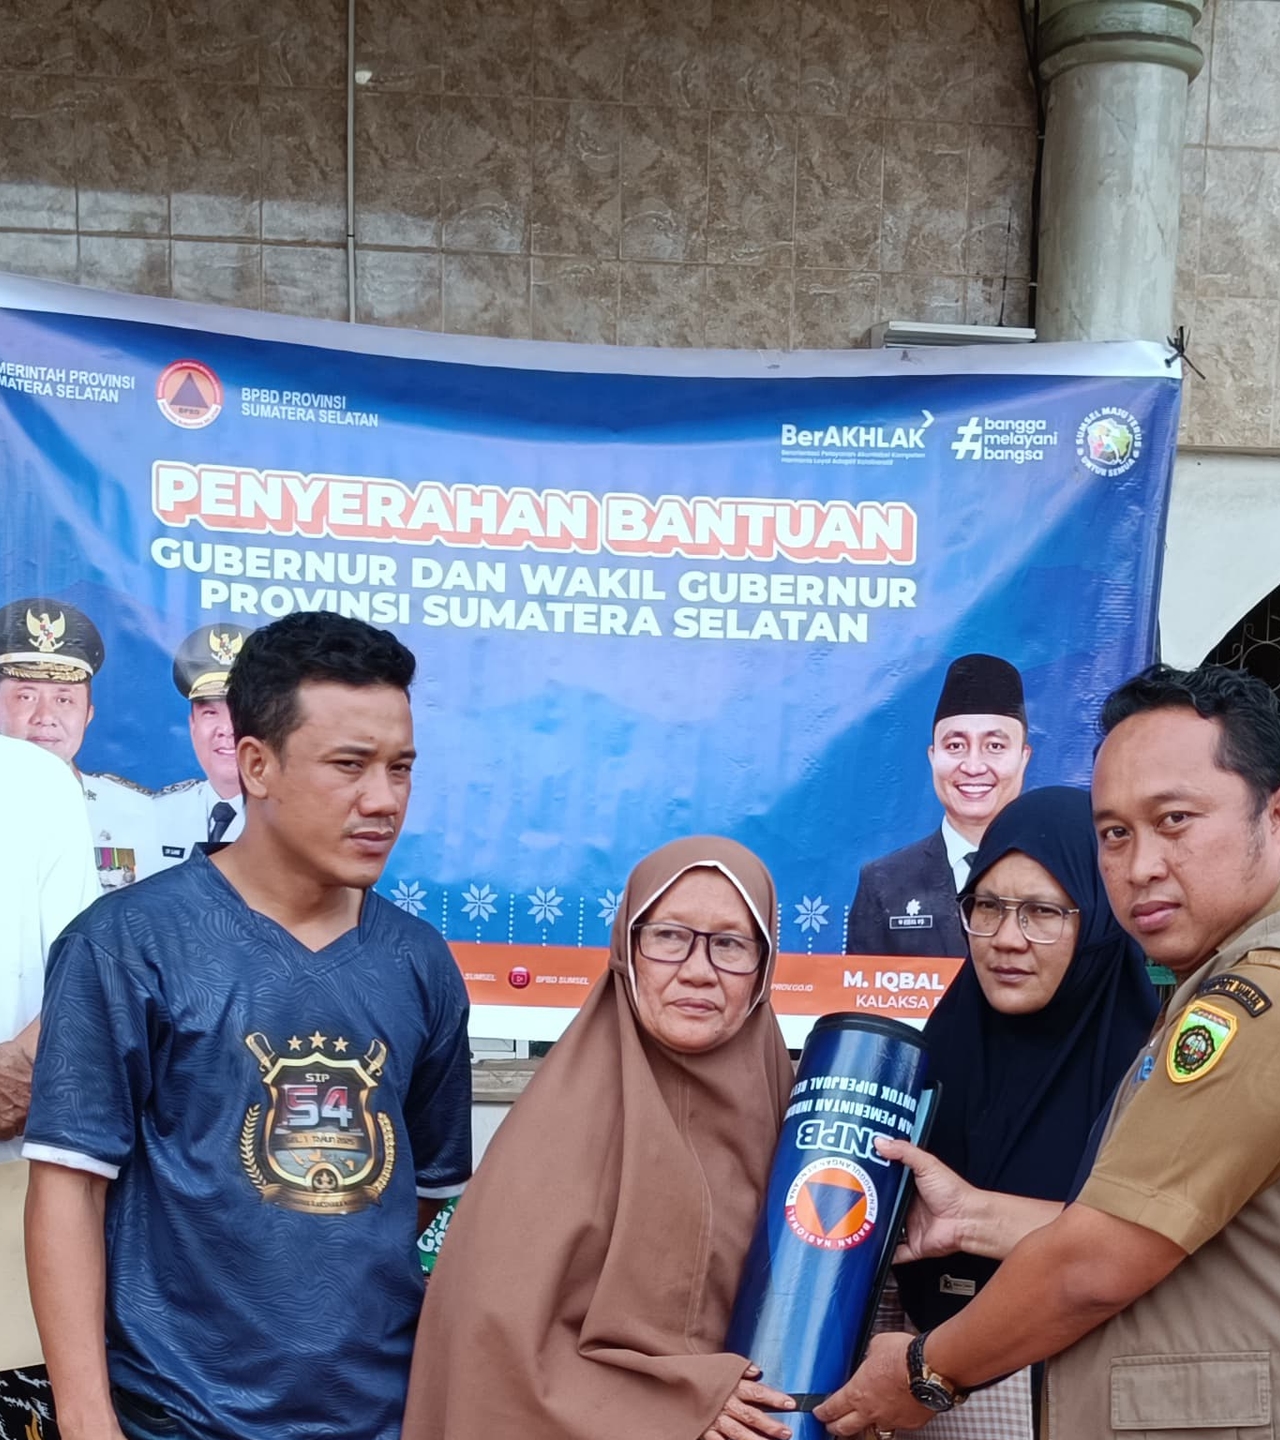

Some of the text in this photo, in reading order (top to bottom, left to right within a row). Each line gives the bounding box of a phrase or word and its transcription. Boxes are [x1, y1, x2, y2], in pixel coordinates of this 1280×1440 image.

[70, 370, 136, 390] PROVINSI
[56, 382, 119, 403] SELATAN
[241, 387, 346, 409] BPBD PROVINSI
[241, 402, 316, 422] SUMATERA
[320, 410, 379, 428] SELATAN
[984, 416, 1047, 434] bangga
[781, 423, 926, 449] BerAKHLAK
[1075, 406, 1142, 447] SUMSEL MAJU TERUS
[984, 431, 1058, 449] melayani
[984, 446, 1044, 464] bangsa
[1108, 458, 1136, 477] SEMUA
[155, 464, 910, 558] PENYERAHAN BANTUAN
[150, 537, 917, 608] GUBERNUR DAN WAKIL GUBERNUR
[200, 578, 868, 643] PROVINSI SUMATERA SELATAN
[843, 971, 945, 993] M. IQBAL
[856, 995, 930, 1009] KALAKSA
[305, 1073, 330, 1082] SIP
[810, 1076, 879, 1097] DIPERJUAL
[282, 1085, 353, 1127] 54
[880, 1085, 917, 1112] UNTUK
[815, 1098, 897, 1127] PEMERINTAH
[787, 1206, 871, 1248] BADAN NASIONAL
